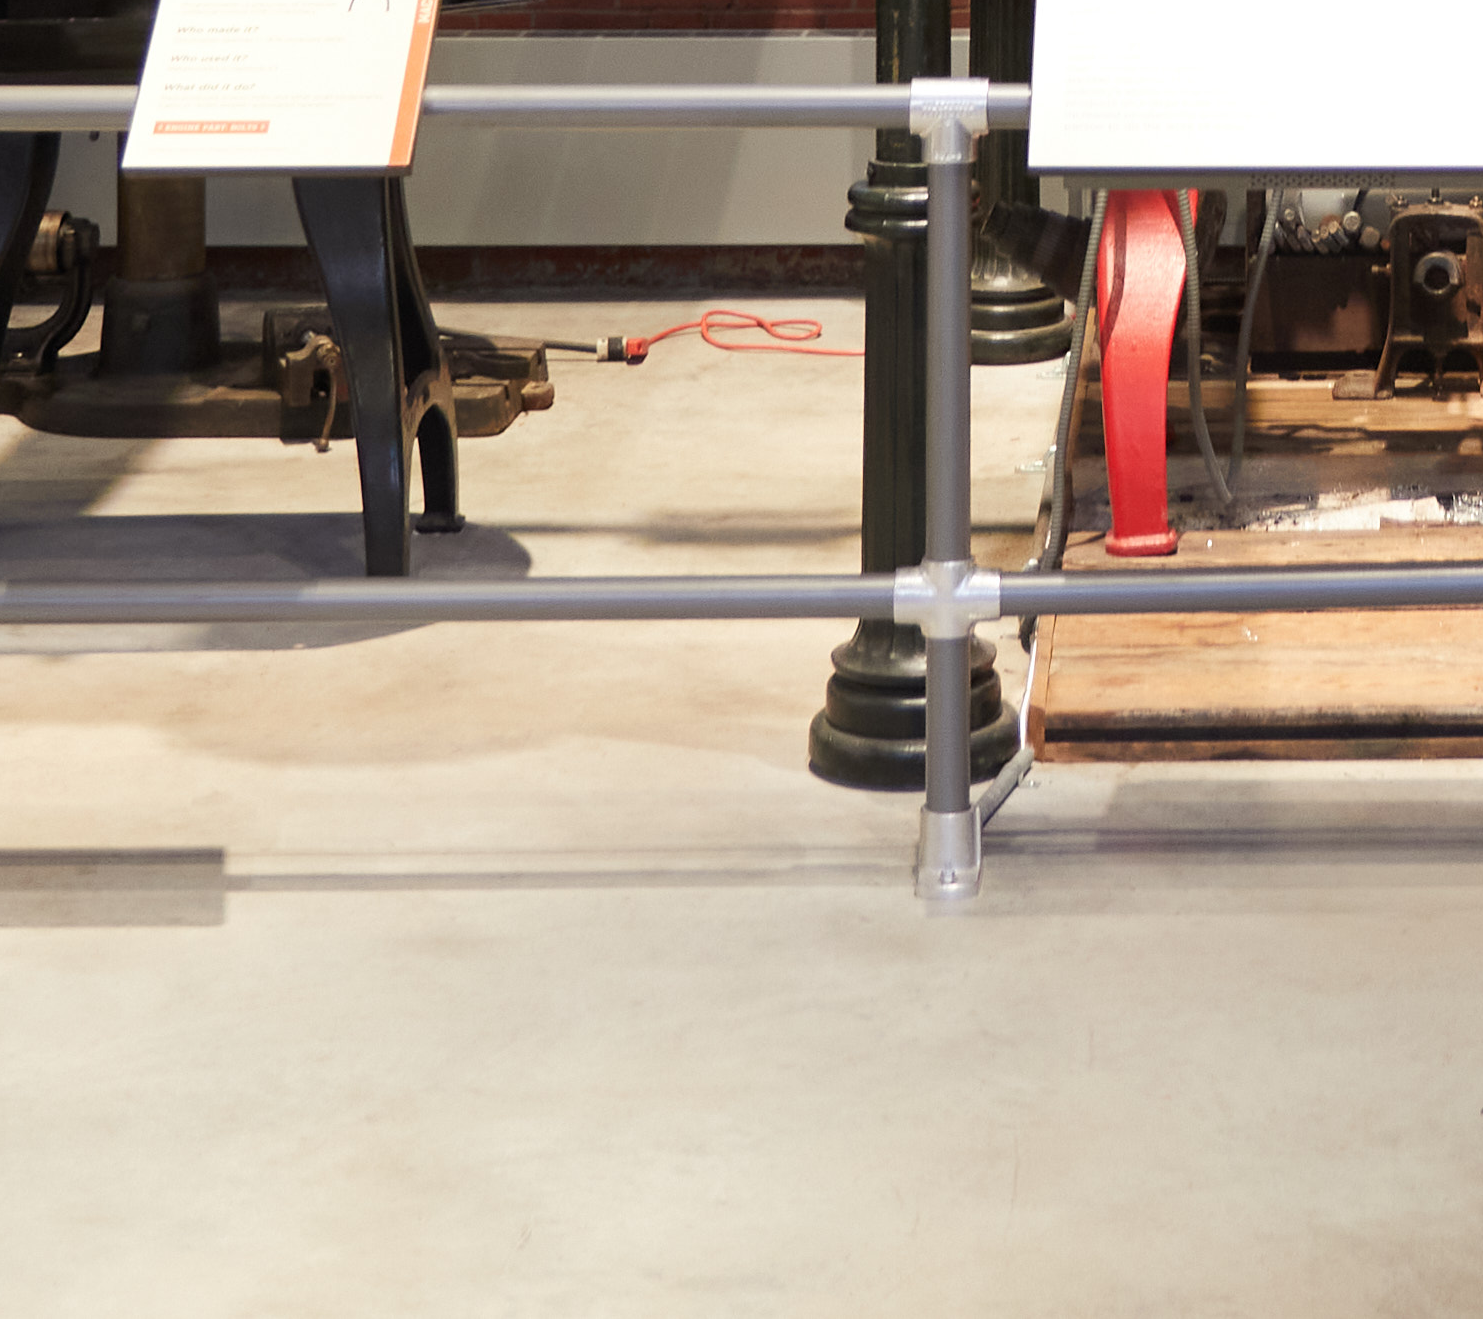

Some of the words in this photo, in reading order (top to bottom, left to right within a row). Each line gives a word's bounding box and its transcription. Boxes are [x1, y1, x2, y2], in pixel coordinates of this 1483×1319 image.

[177, 26, 205, 34] Who
[207, 26, 241, 34] made
[243, 26, 259, 34] it?
[170, 54, 198, 63] Who
[200, 54, 233, 63] used
[233, 54, 249, 63] it?
[163, 83, 195, 92] What
[198, 83, 219, 92] did
[220, 83, 230, 92] it
[233, 83, 257, 92] do?
